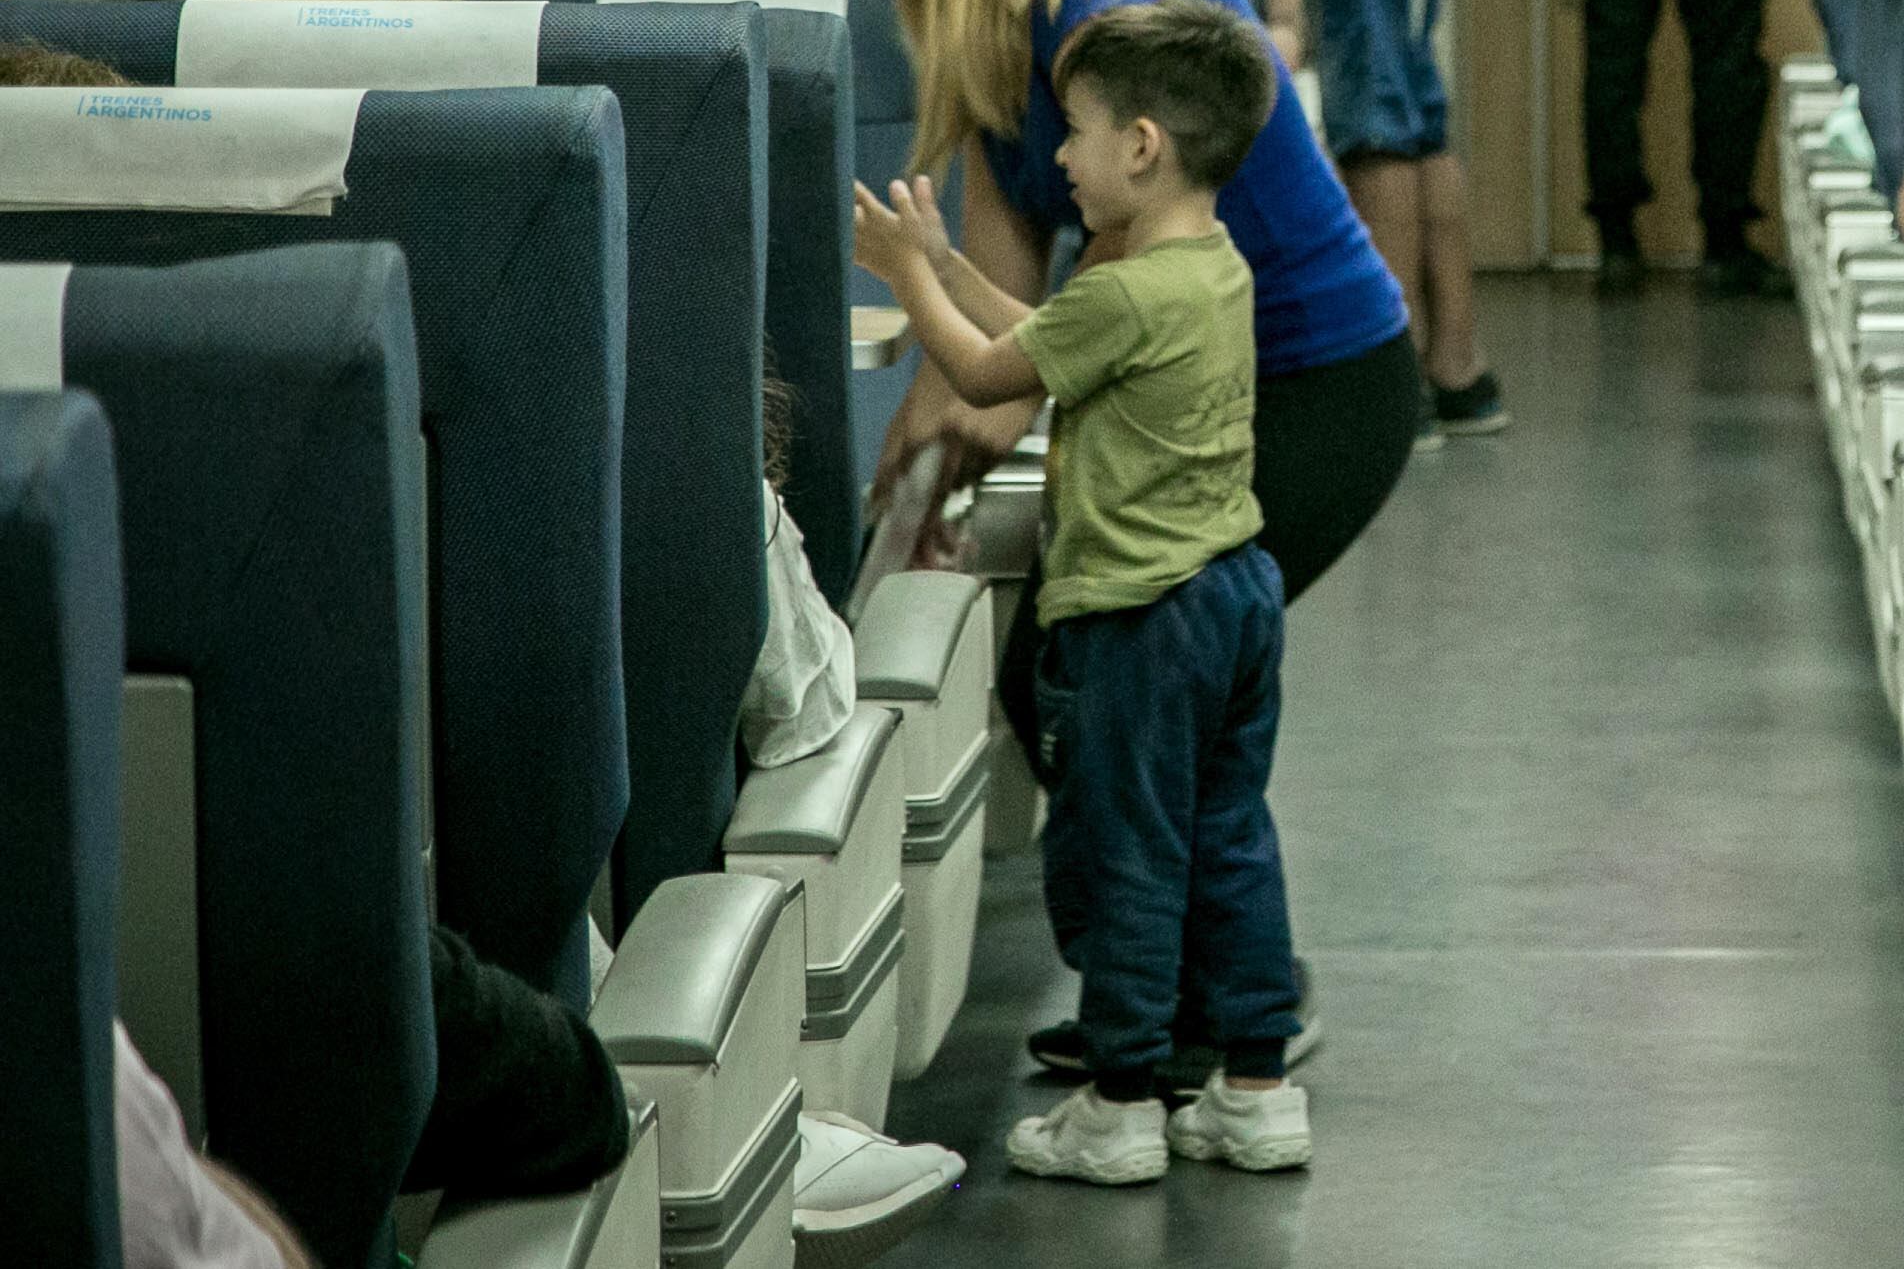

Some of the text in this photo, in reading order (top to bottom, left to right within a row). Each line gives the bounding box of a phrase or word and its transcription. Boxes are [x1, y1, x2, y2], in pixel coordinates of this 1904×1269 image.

[307, 8, 371, 16] TRENES
[305, 17, 414, 28] ARGENTINOS
[91, 96, 163, 106] TRENES
[86, 106, 213, 121] ARGENTINOS
